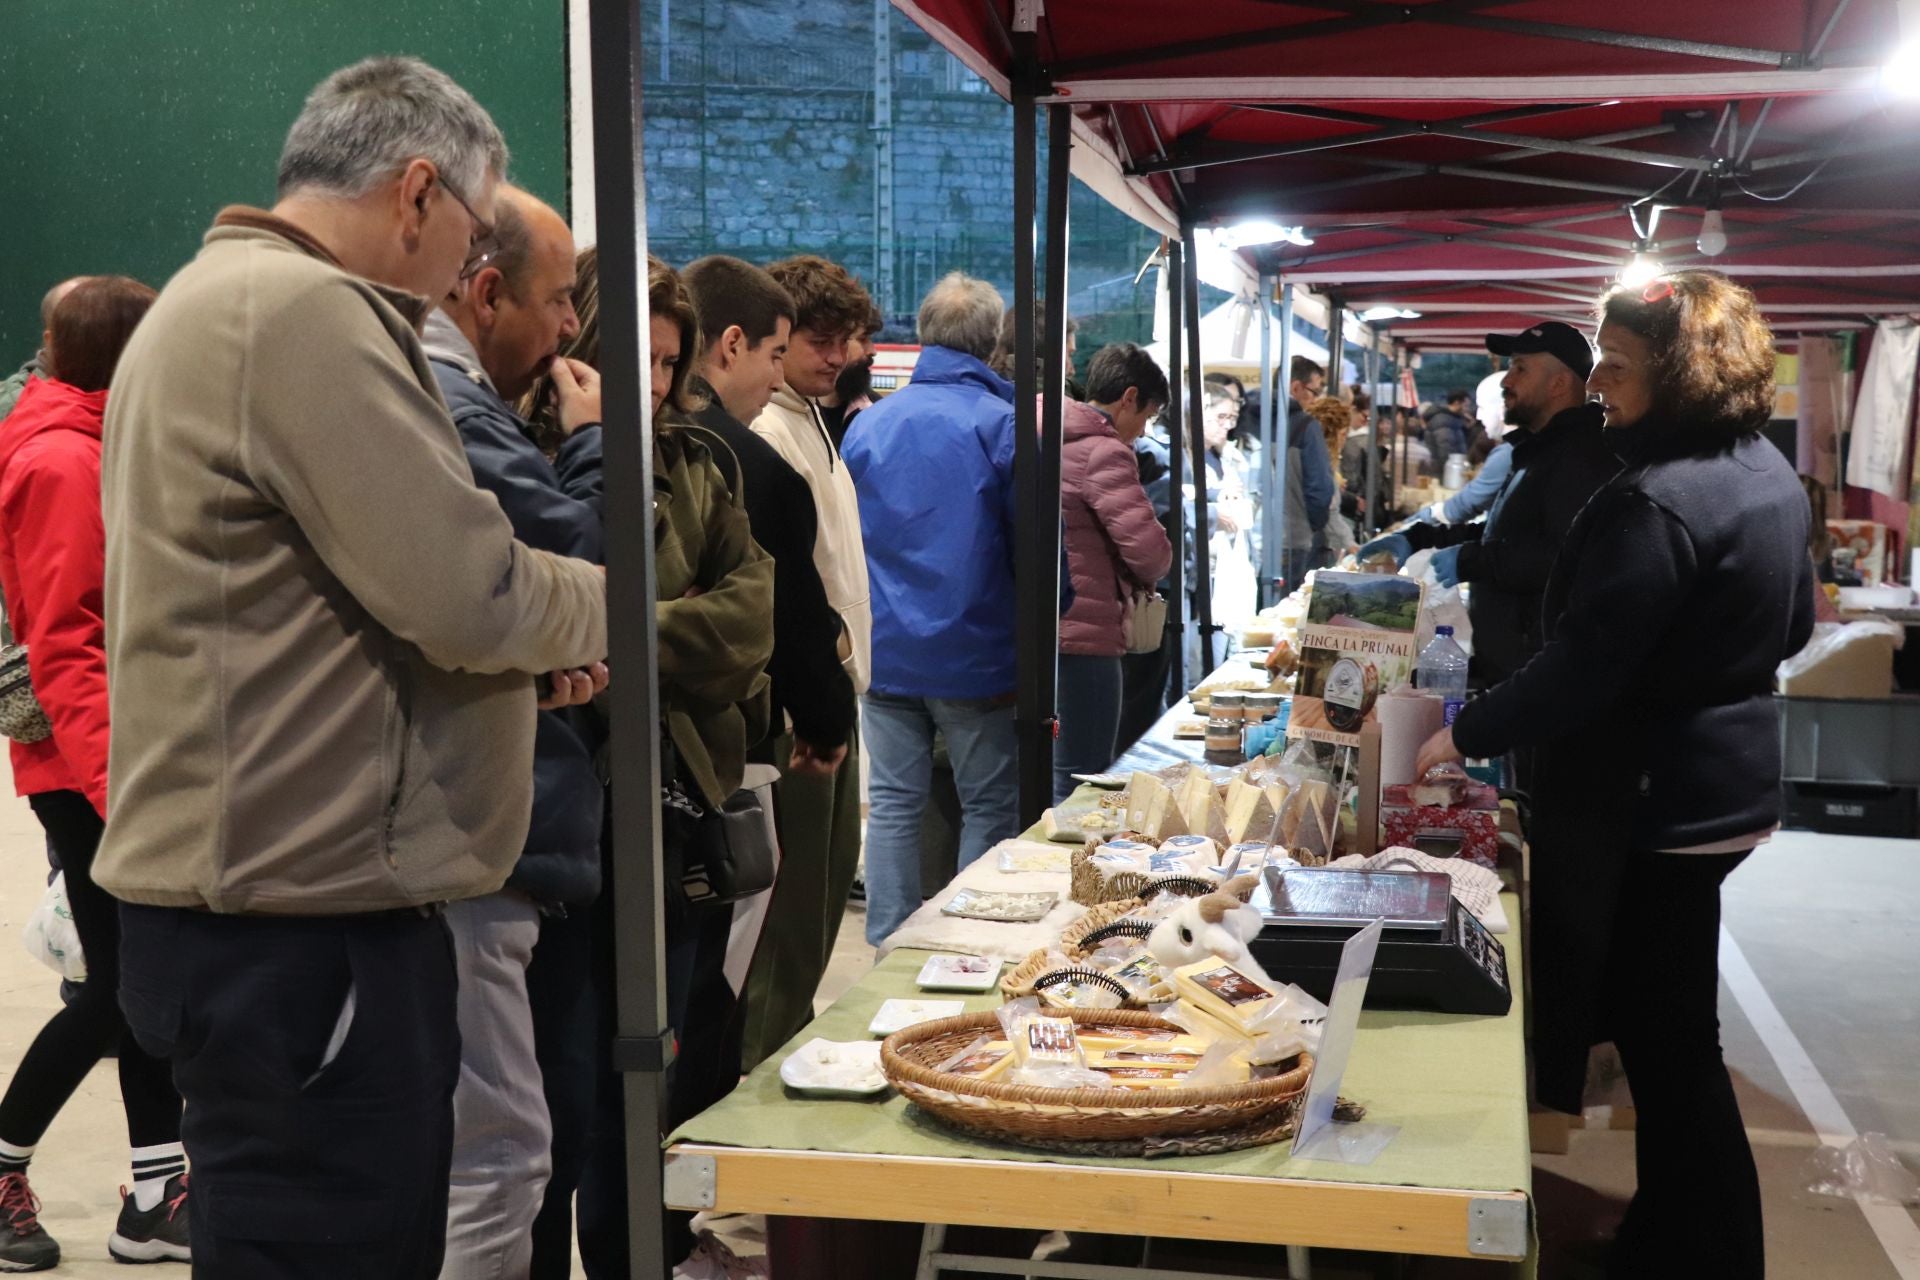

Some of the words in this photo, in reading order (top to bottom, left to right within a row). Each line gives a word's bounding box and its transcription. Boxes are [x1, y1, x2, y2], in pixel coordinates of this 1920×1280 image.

[1303, 633, 1339, 649] FINCA
[1343, 638, 1357, 651] LA
[1361, 640, 1409, 657] PRUNAL
